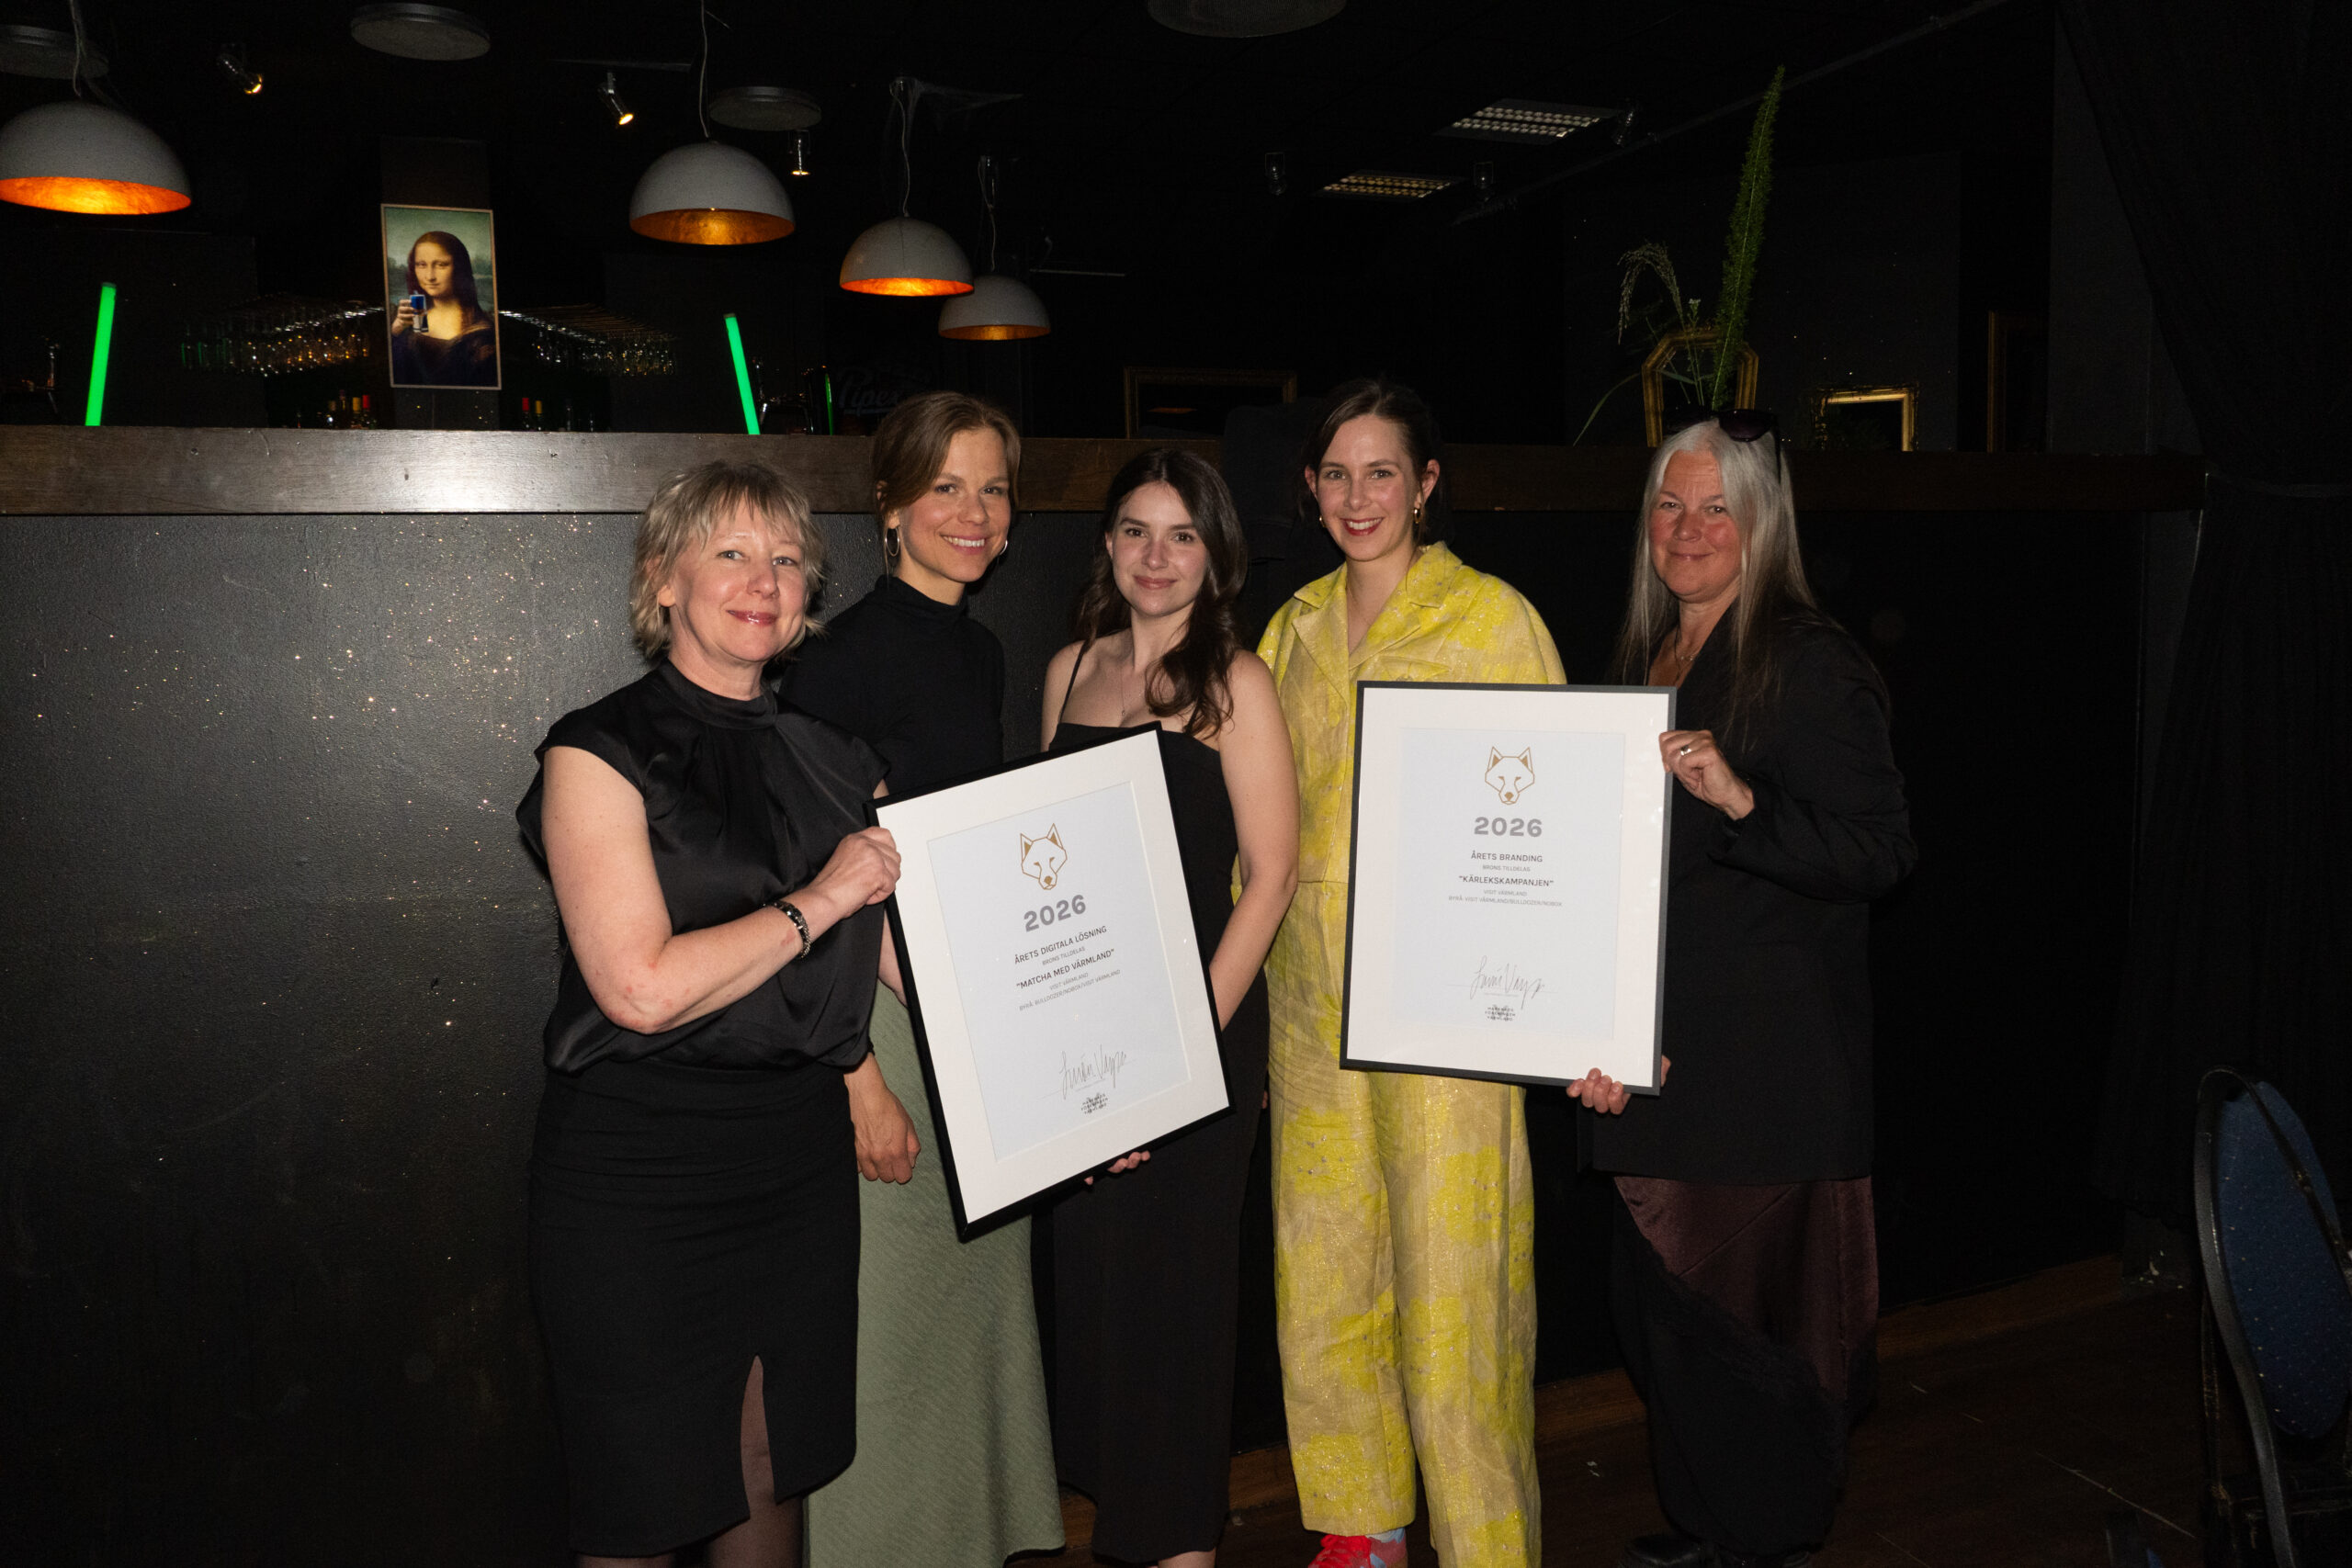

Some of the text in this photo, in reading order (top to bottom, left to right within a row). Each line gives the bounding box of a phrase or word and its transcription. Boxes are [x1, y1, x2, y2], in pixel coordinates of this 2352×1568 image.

[1474, 817, 1543, 838] 2026
[1470, 850, 1544, 863] ÅRETS BRANDING
[1458, 874, 1555, 887] "KÄRLEKSKAMPANJEN"
[1023, 894, 1087, 932] 2026
[1014, 925, 1108, 965] ÅRETS DIGITALA LÖSNING
[1016, 948, 1115, 989] "MATCHA MED VÄRMLAND"
